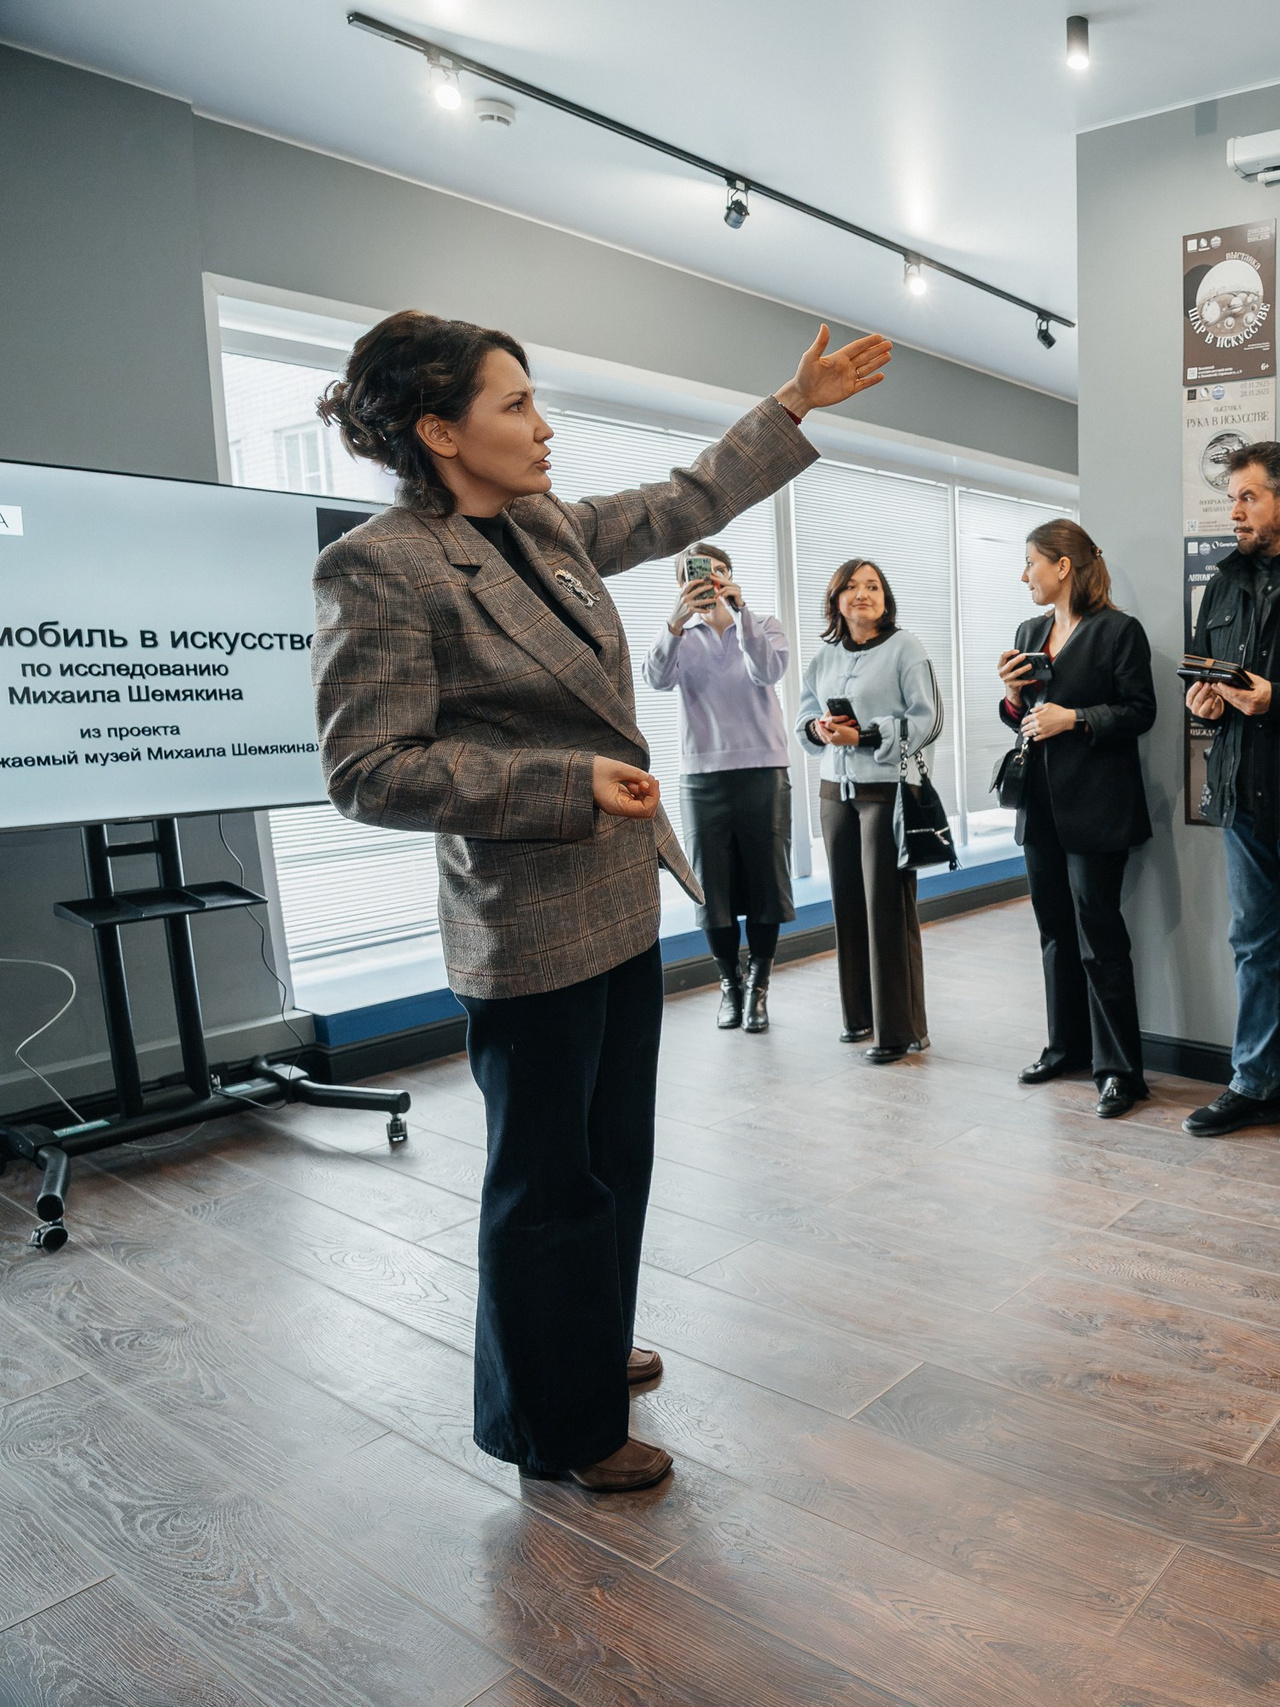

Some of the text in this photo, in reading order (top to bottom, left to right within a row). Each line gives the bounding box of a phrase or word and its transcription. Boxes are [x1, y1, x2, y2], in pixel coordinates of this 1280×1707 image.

[1188, 303, 1271, 348] ШАР В ИСКУССТВЕ
[1260, 362, 1270, 371] 6+
[1187, 411, 1270, 428] РУКА В ИСКУССТВЕ
[140, 629, 159, 648] в
[21, 663, 229, 679] по исследованию
[8, 685, 243, 704] Михаила Шемякина
[80, 724, 181, 741] из проекта
[85, 747, 142, 766] музей
[147, 746, 226, 760] Михаила
